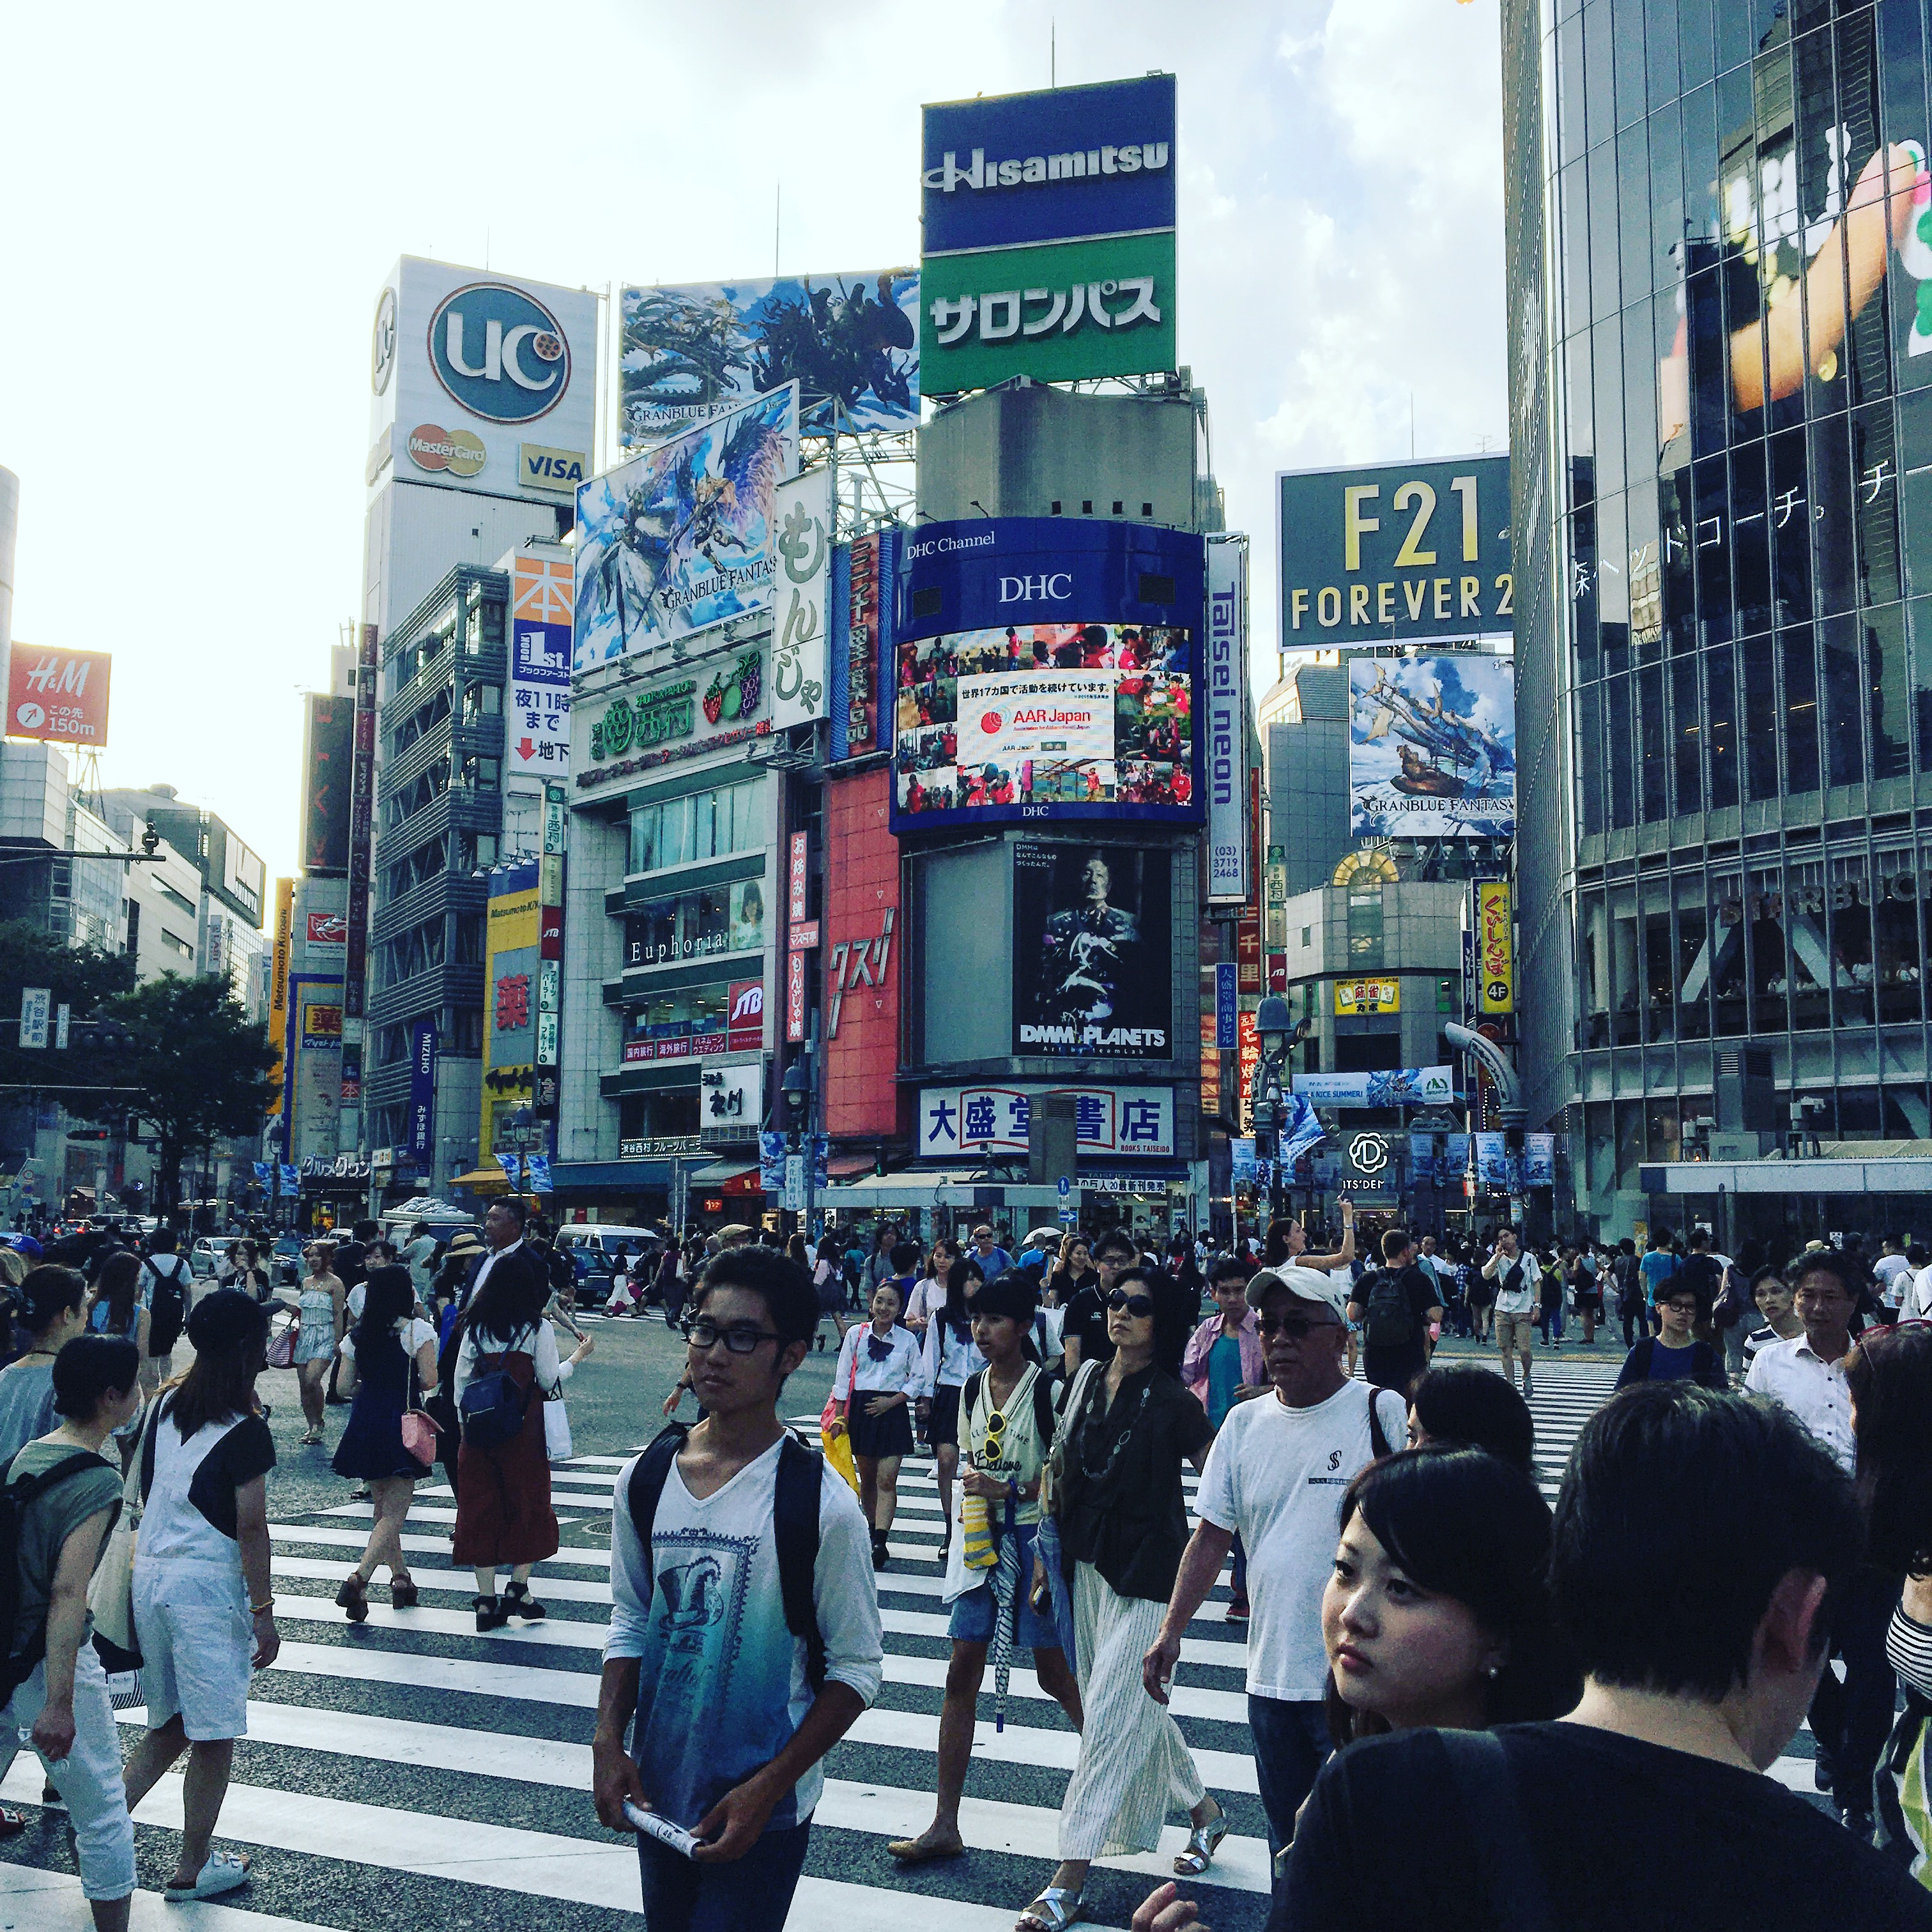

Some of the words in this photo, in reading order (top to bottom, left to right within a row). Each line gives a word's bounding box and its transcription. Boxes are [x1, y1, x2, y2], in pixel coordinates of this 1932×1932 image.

[921, 142, 1168, 191] Hisamitsu
[930, 276, 1160, 344] サロンパス
[631, 407, 705, 422] GRANBLUE
[410, 437, 486, 461] MasterCard
[528, 456, 584, 482] VISA
[907, 541, 935, 560] DHC
[937, 531, 995, 553] Channel
[663, 575, 726, 610] GRANBLUE
[999, 573, 1072, 602] DHC
[778, 502, 824, 715] もんじゃ
[1292, 576, 1481, 629] FOREVER
[1213, 581, 1236, 697] Taisei
[26, 656, 91, 698] H&M
[962, 683, 1110, 700] 世界17カ国で活動を続けています。
[49, 705, 84, 719] この先
[1013, 709, 1046, 724] AAR
[1048, 709, 1091, 724] Japan
[49, 717, 95, 735] 150m
[526, 713, 559, 732] まで
[538, 741, 570, 762] 地下
[1215, 710, 1231, 804] neon
[1022, 806, 1049, 817] DHC
[1367, 799, 1446, 812] GRANBLUE
[1215, 846, 1236, 857] (03)
[1214, 858, 1238, 869] 3719
[1214, 868, 1239, 878] 2468
[793, 837, 804, 917] お好み焼
[543, 928, 559, 938] JTB
[631, 930, 723, 963] Euphoria
[1488, 985, 1506, 997] 4F
[731, 986, 763, 1022] JTB
[421, 1033, 431, 1074] MIZUHO
[627, 1045, 654, 1059] 国内旅行
[659, 1041, 687, 1055] 海外旅行
[1332, 1090, 1363, 1098] SUMMER!
[415, 1105, 426, 1150] みずほ銀行
[1077, 1179, 1165, 1192] の巨人20最新刊発売
[1009, 1429, 1030, 1445] TIME
